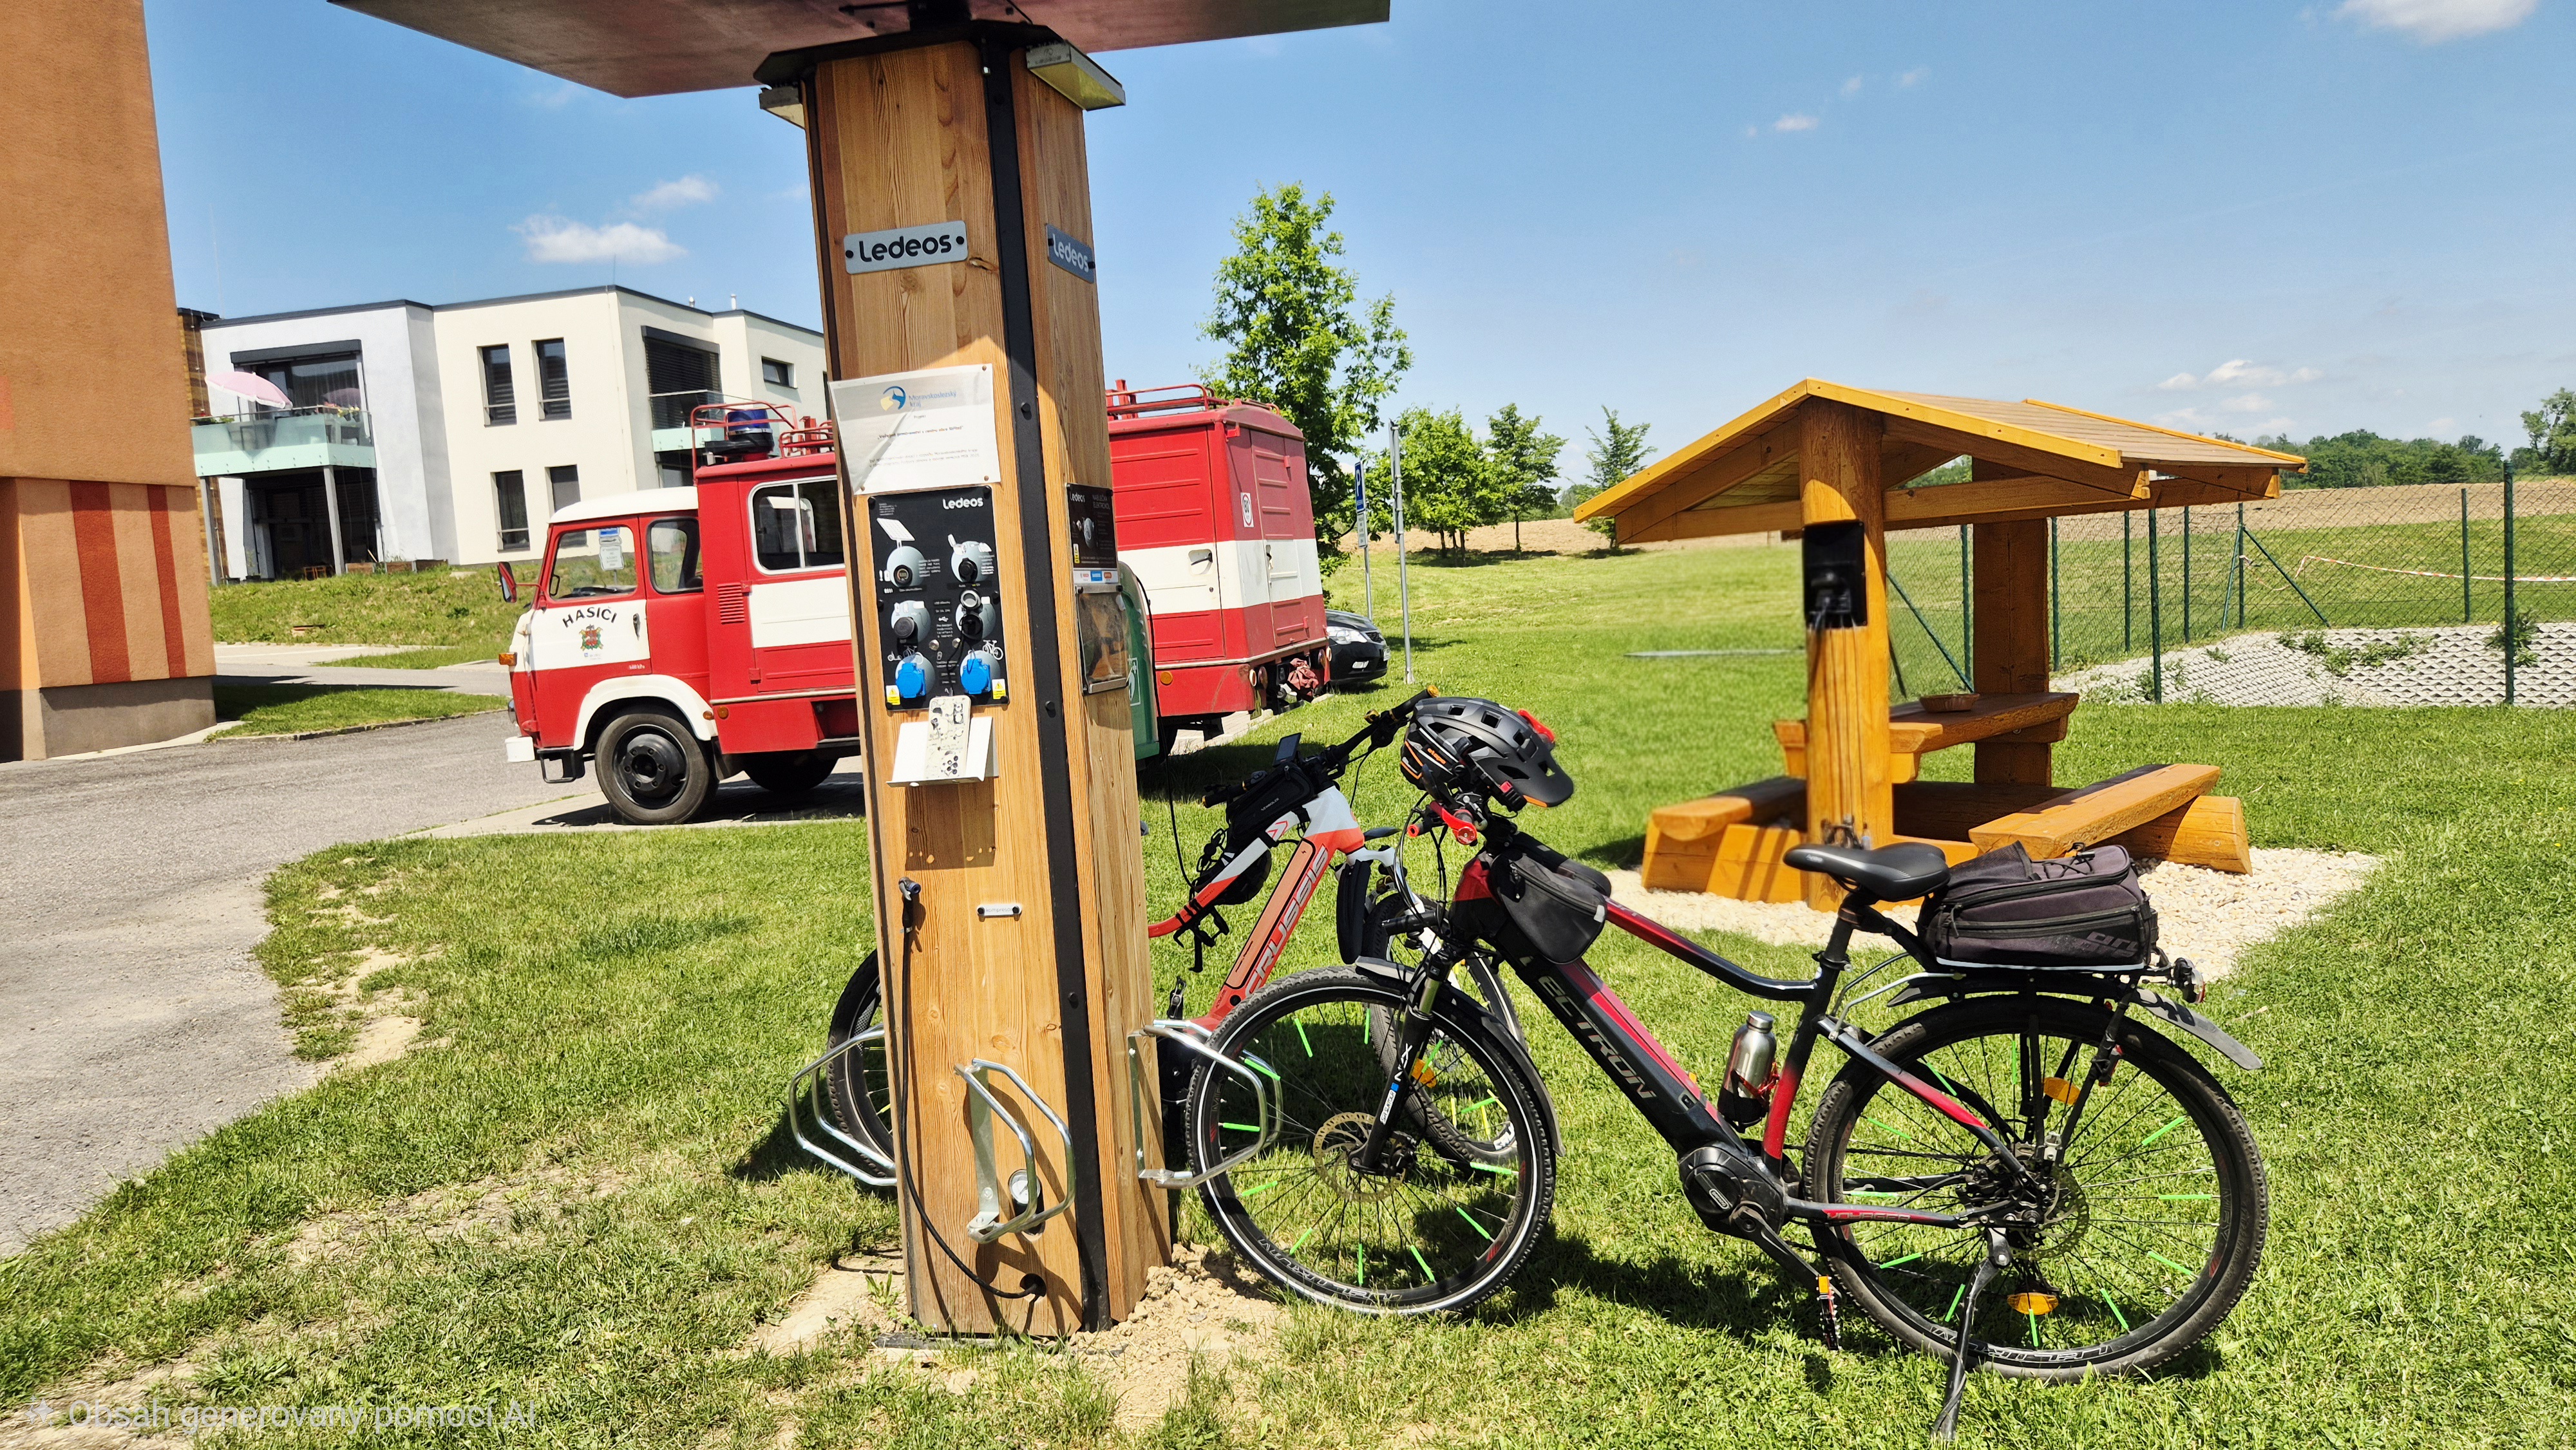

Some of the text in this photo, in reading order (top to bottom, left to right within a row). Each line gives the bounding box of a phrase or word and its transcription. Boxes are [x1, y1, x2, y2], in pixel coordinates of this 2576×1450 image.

[859, 234, 952, 262] Ledeos
[1052, 234, 1090, 273] Ledeos
[909, 390, 957, 401] Moravskoslezský
[1356, 469, 1361, 496] P
[942, 497, 984, 509] Ledeos
[1070, 491, 1085, 502] Ledeos
[1244, 500, 1249, 513] 80
[562, 607, 617, 628] HASIČI
[1427, 748, 1447, 764] etape
[1245, 843, 1329, 995] CRUSSIS
[1827, 1212, 1911, 1222] VOYAGER
